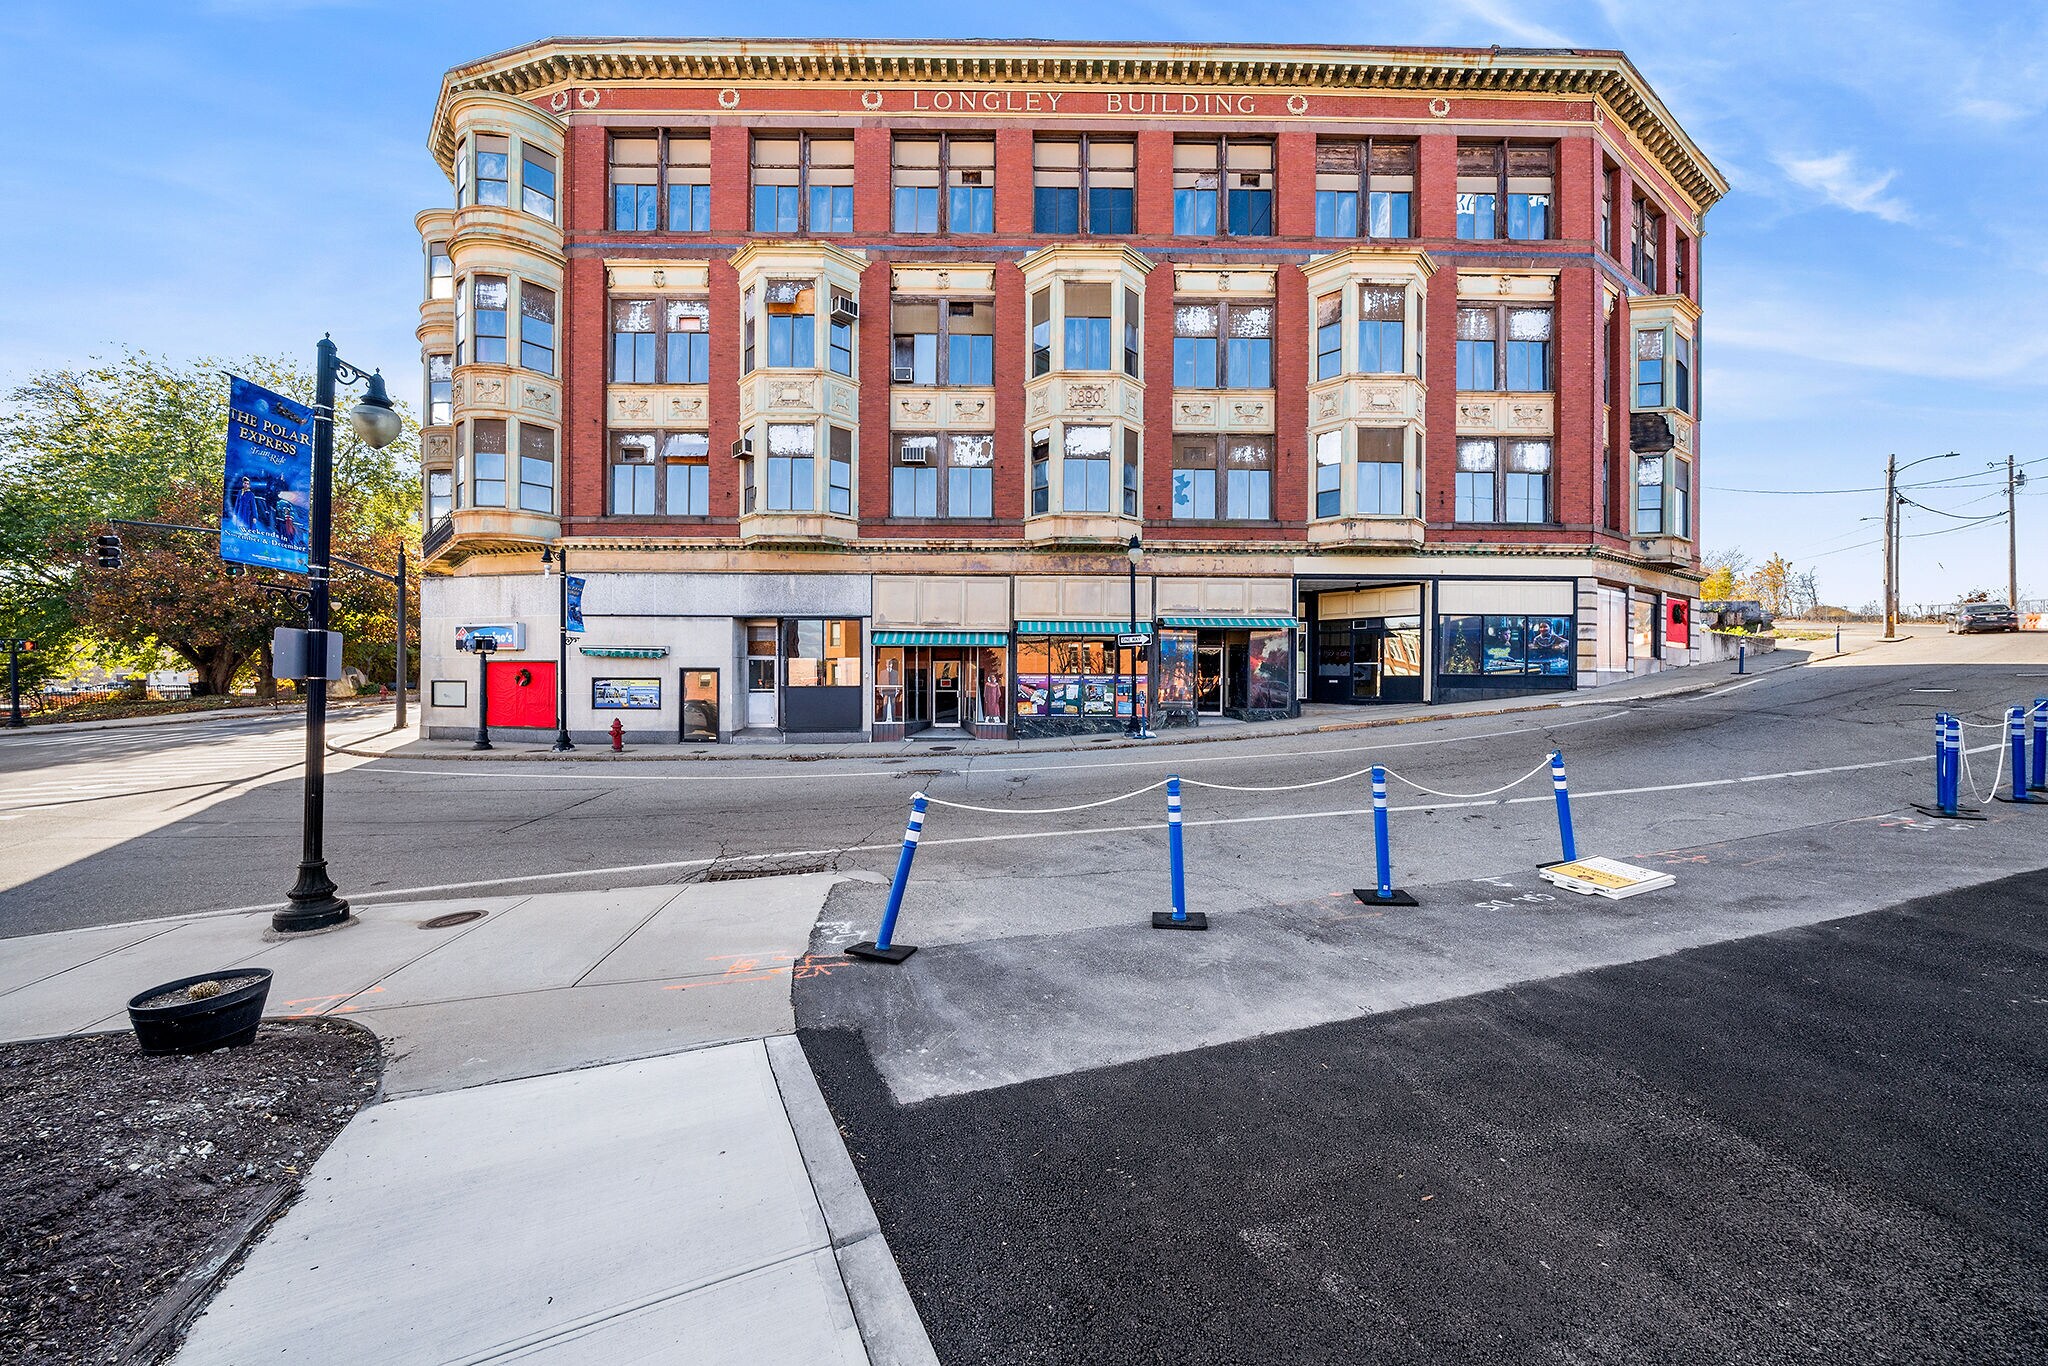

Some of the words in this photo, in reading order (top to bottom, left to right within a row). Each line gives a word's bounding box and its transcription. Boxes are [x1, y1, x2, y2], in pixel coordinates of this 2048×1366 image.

[913, 91, 1063, 112] LONGLEY
[1106, 93, 1256, 115] BUILDING
[230, 406, 258, 428] THE
[263, 419, 311, 446] POLAR
[239, 427, 297, 455] EXPRESS
[250, 446, 270, 458] Train
[269, 454, 287, 466] Ride
[224, 529, 260, 543] November
[271, 539, 307, 552] December
[239, 526, 280, 540] Weekends
[280, 533, 288, 542] in
